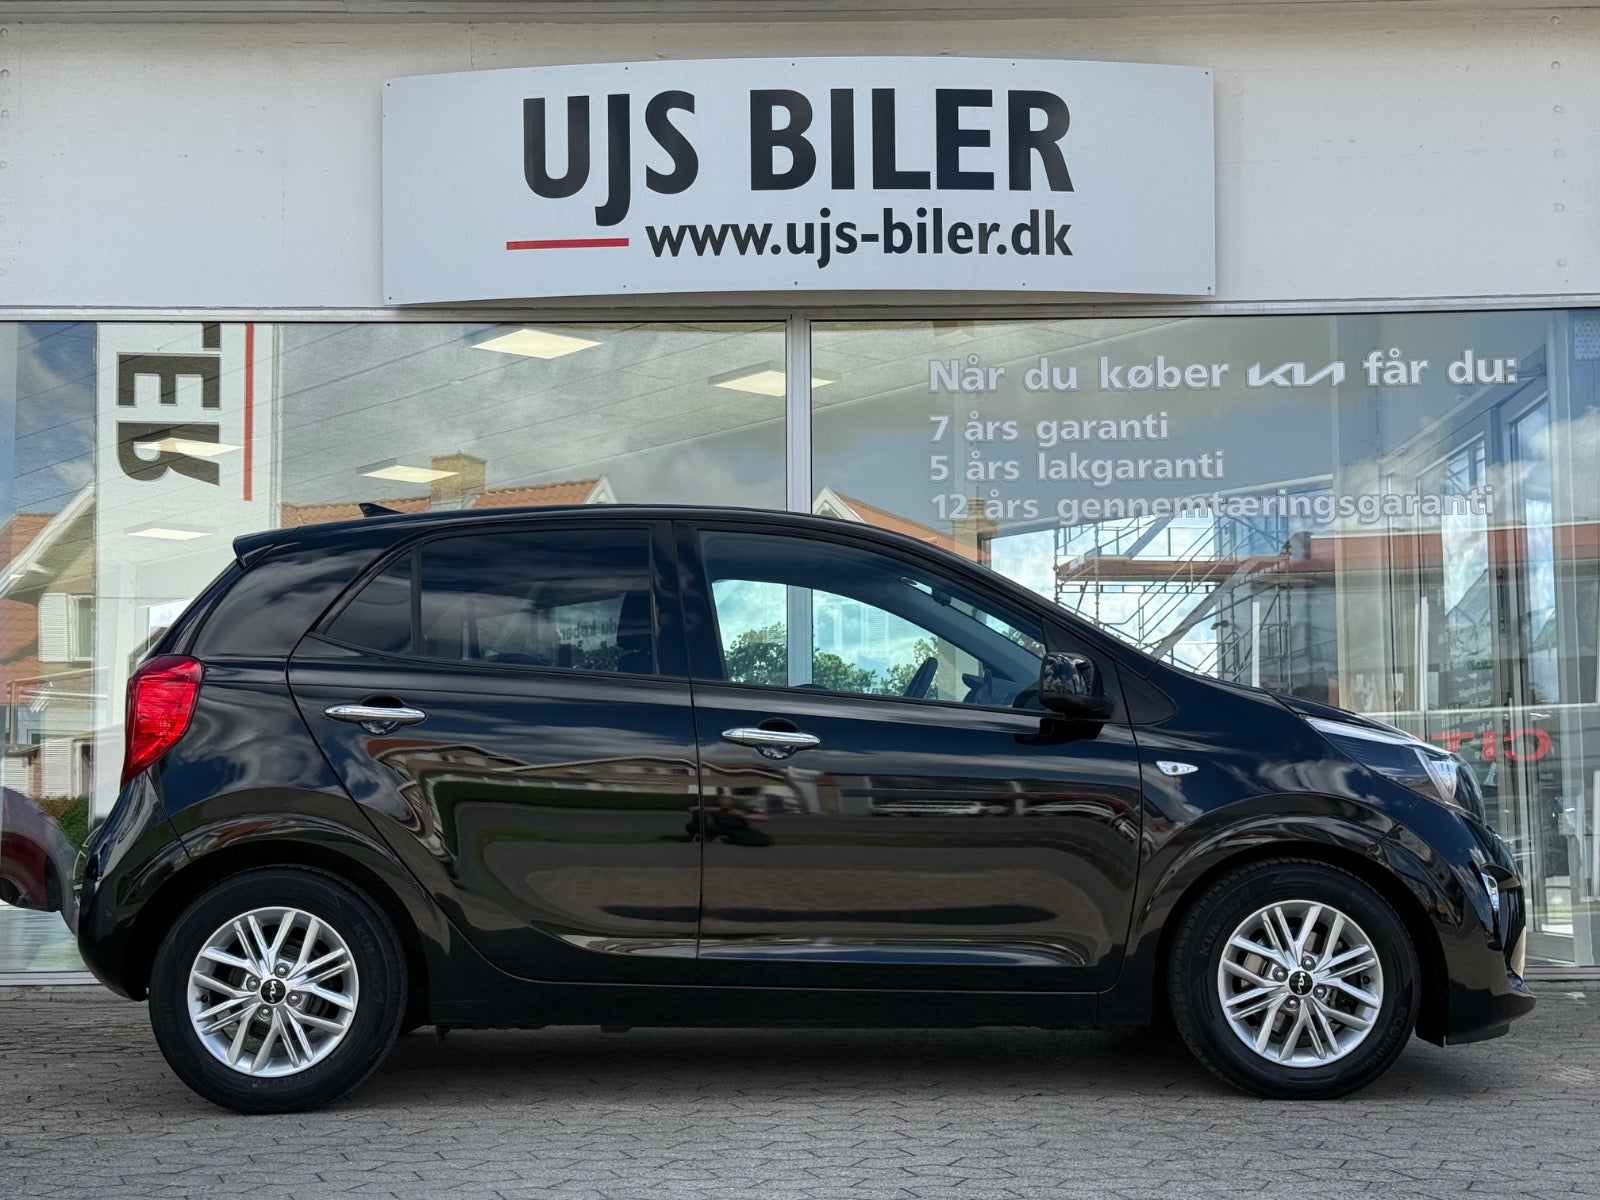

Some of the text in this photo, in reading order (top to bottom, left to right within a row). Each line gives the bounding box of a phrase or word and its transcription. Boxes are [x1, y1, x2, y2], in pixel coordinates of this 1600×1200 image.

[523, 88, 1075, 227] UJS BILER
[645, 207, 1074, 269] www.ujs-biler.dk
[929, 354, 1005, 392] Når
[1024, 357, 1079, 391] du
[1099, 355, 1230, 391] køber
[1363, 348, 1428, 386] får
[1448, 349, 1520, 384] du:
[929, 410, 1169, 448] 7 års garanti
[930, 450, 1224, 487] 5 års lakgaranti
[932, 486, 1495, 526] 12 års gennemtæringsgaranti
